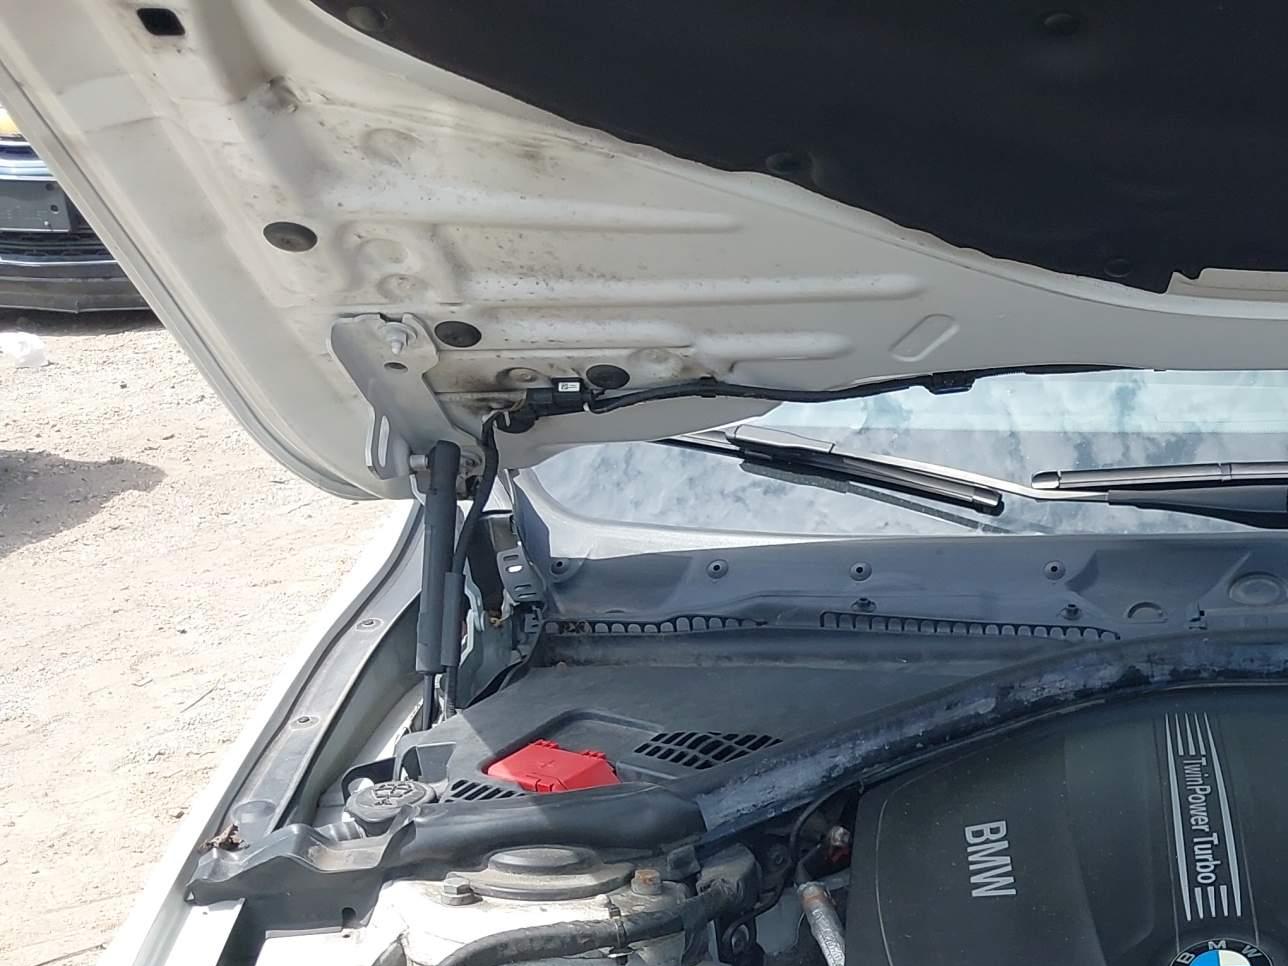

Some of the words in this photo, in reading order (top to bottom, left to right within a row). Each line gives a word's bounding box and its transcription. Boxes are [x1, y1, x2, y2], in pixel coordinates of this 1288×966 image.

[1182, 755, 1212, 832] TwinPower
[964, 820, 1017, 897] BMW
[1192, 832, 1220, 885] Turbo
[1177, 940, 1263, 964] BMW
